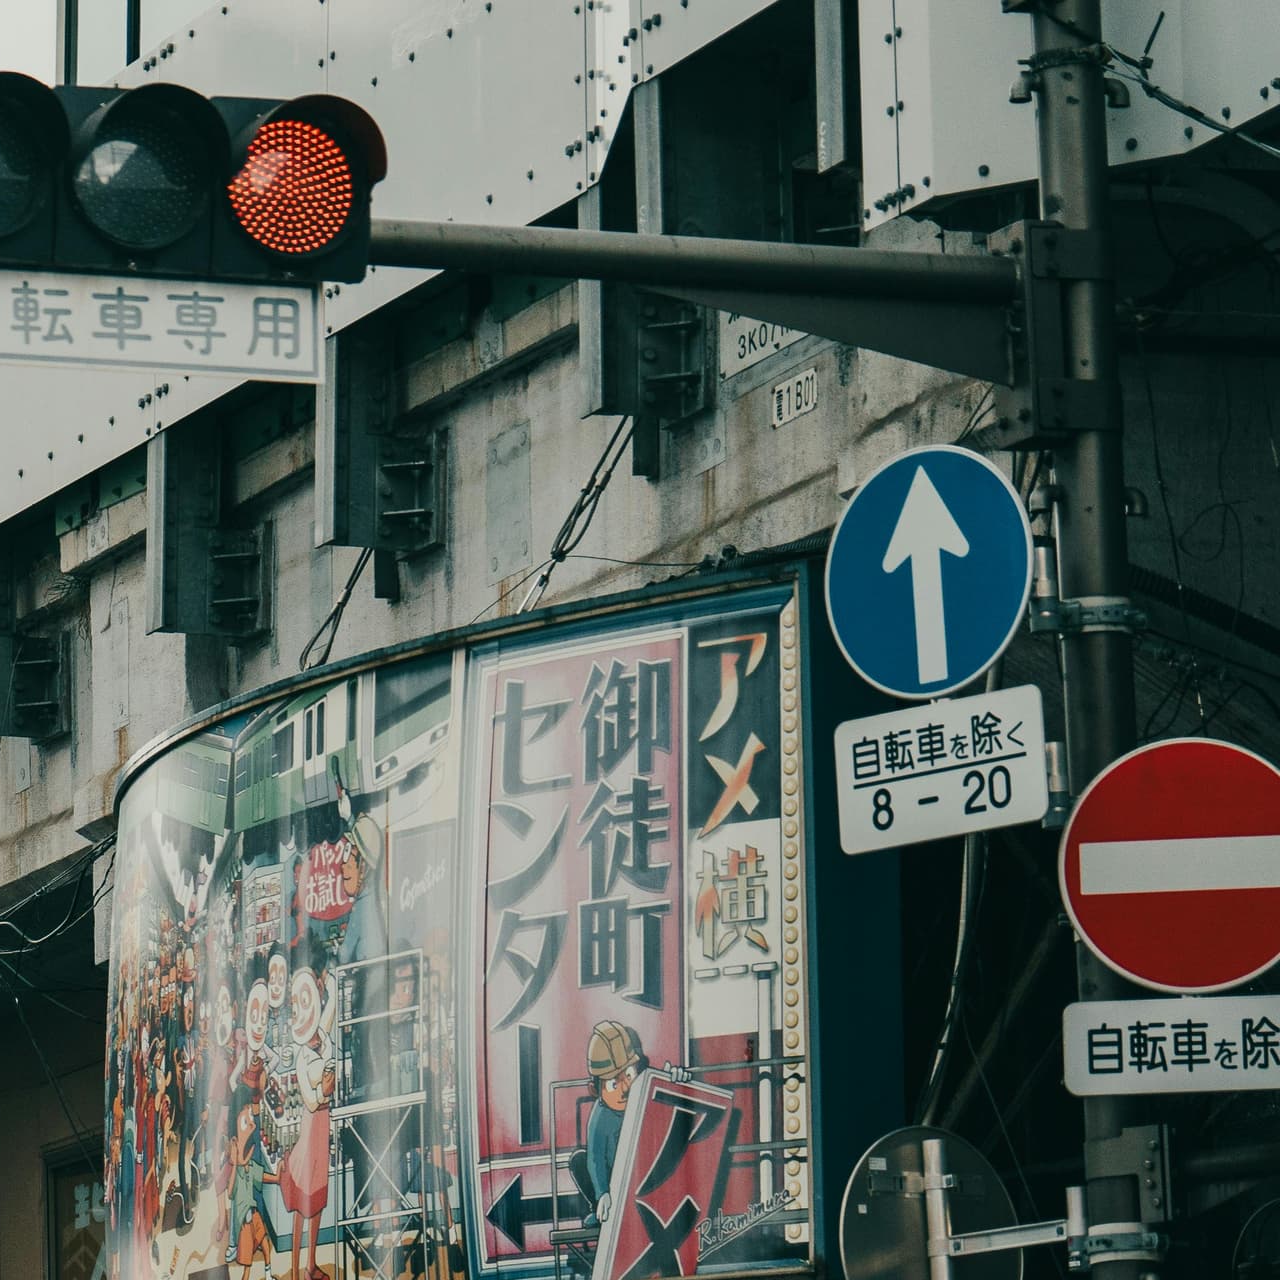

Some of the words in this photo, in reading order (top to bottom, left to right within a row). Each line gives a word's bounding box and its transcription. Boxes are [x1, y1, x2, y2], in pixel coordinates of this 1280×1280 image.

[579, 656, 673, 1011] 御徒町
[694, 630, 768, 961] アメ横
[851, 711, 1026, 780] 自転車を除く
[485, 677, 574, 1146] センター
[1087, 1015, 1280, 1075] 自転車を除
